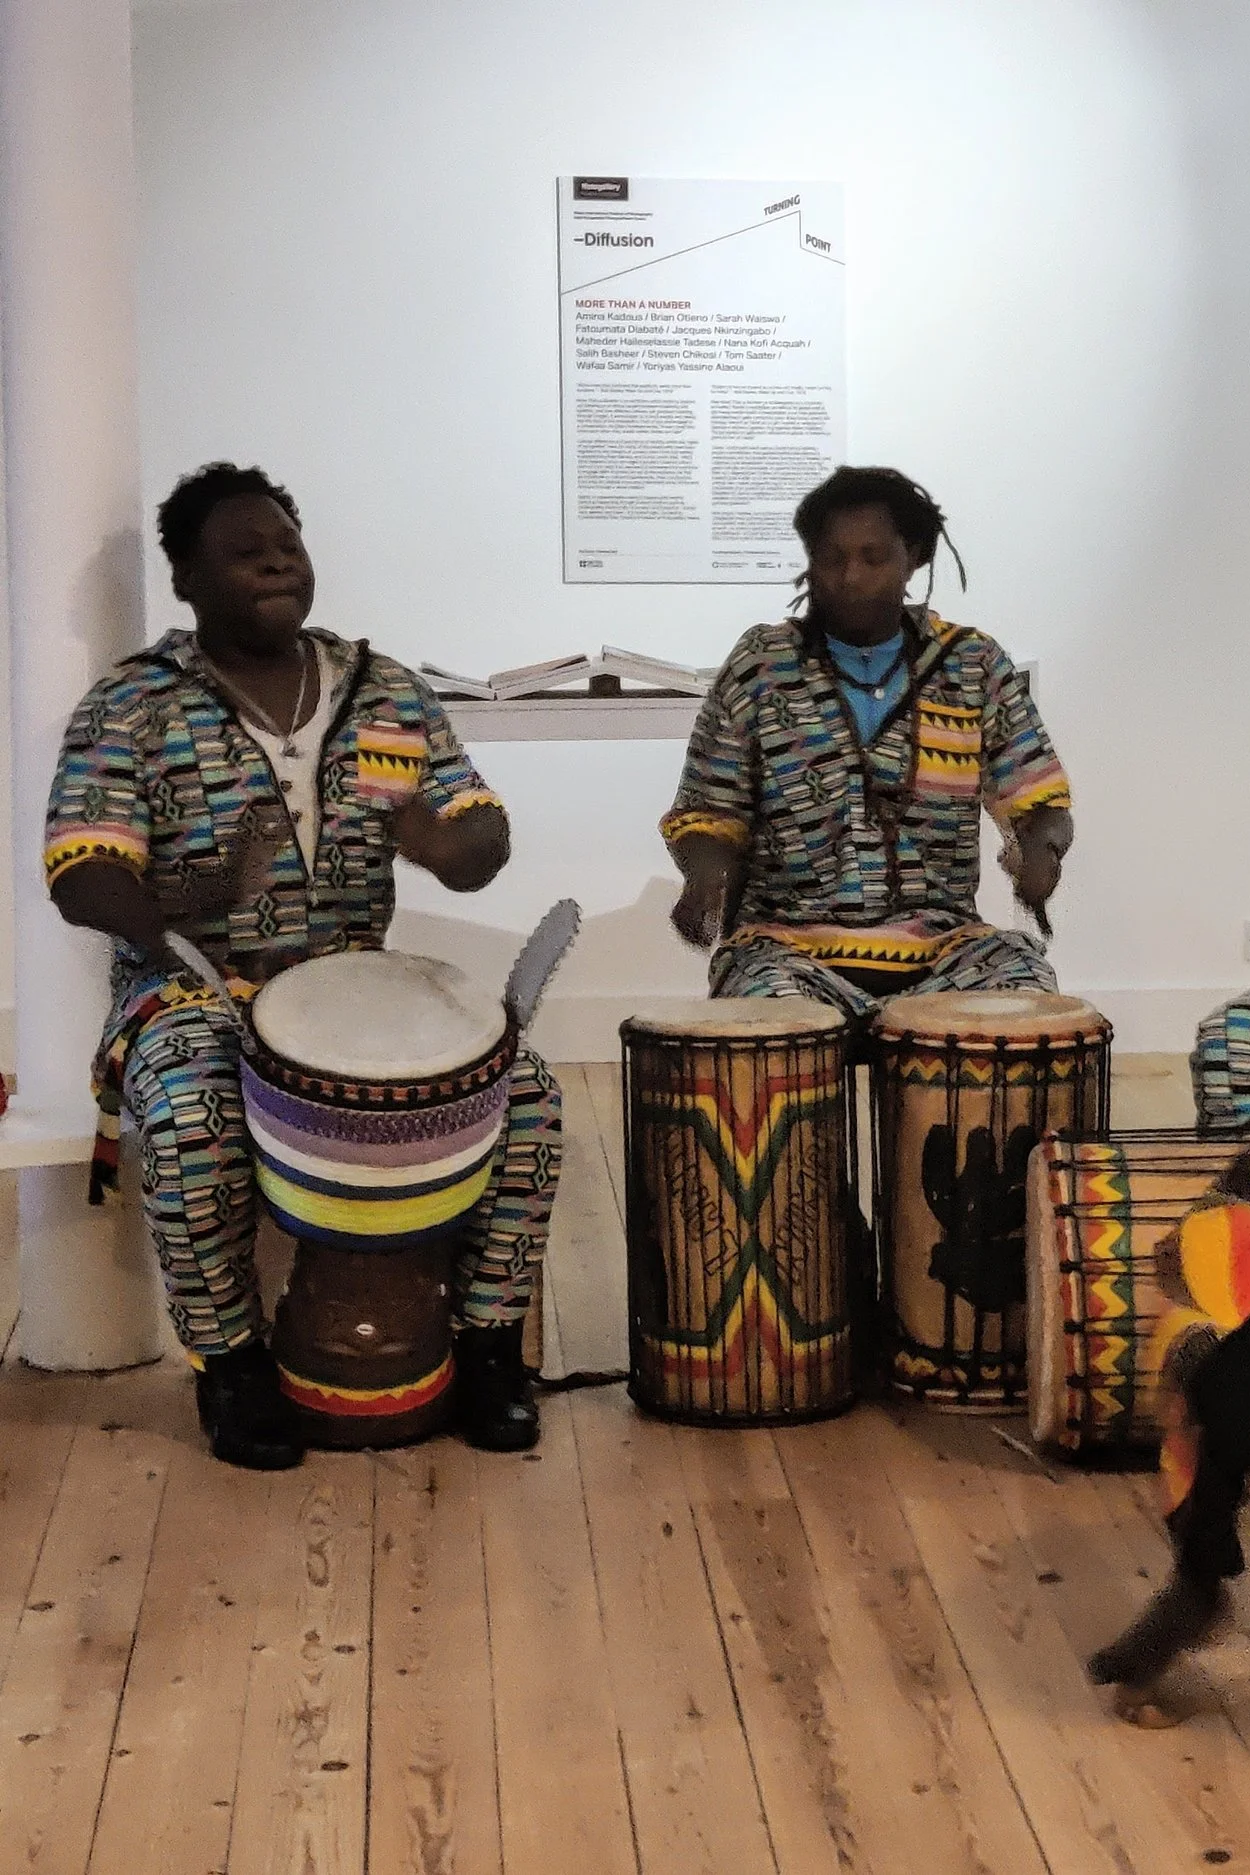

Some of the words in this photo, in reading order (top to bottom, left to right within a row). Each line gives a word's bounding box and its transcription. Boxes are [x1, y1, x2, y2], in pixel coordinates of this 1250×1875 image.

[764, 194, 801, 216] TURNING
[575, 299, 605, 309] MORE
[608, 300, 636, 309] THAN
[638, 300, 646, 309] A
[648, 301, 691, 310] NUMBER
[575, 312, 605, 321] Amina
[607, 312, 643, 321] Kadous
[651, 313, 675, 322] Brian
[676, 313, 708, 322] Otieno
[716, 313, 743, 323] Sarah
[745, 314, 781, 323] Waiswa
[575, 324, 626, 333] Fatoumata
[628, 324, 664, 334] Diabaté
[672, 325, 712, 336] Jacques
[714, 326, 771, 337] Nkinzingabo
[575, 336, 617, 345] Maheder
[683, 338, 717, 347] Tadese
[724, 339, 748, 347] Nana
[750, 339, 768, 348] Kofi
[770, 339, 806, 349] Acquah
[576, 348, 599, 358] Salih
[601, 348, 640, 358] Basheer
[648, 350, 681, 358] Steven
[725, 350, 744, 359] Tom
[607, 361, 635, 370] Samir
